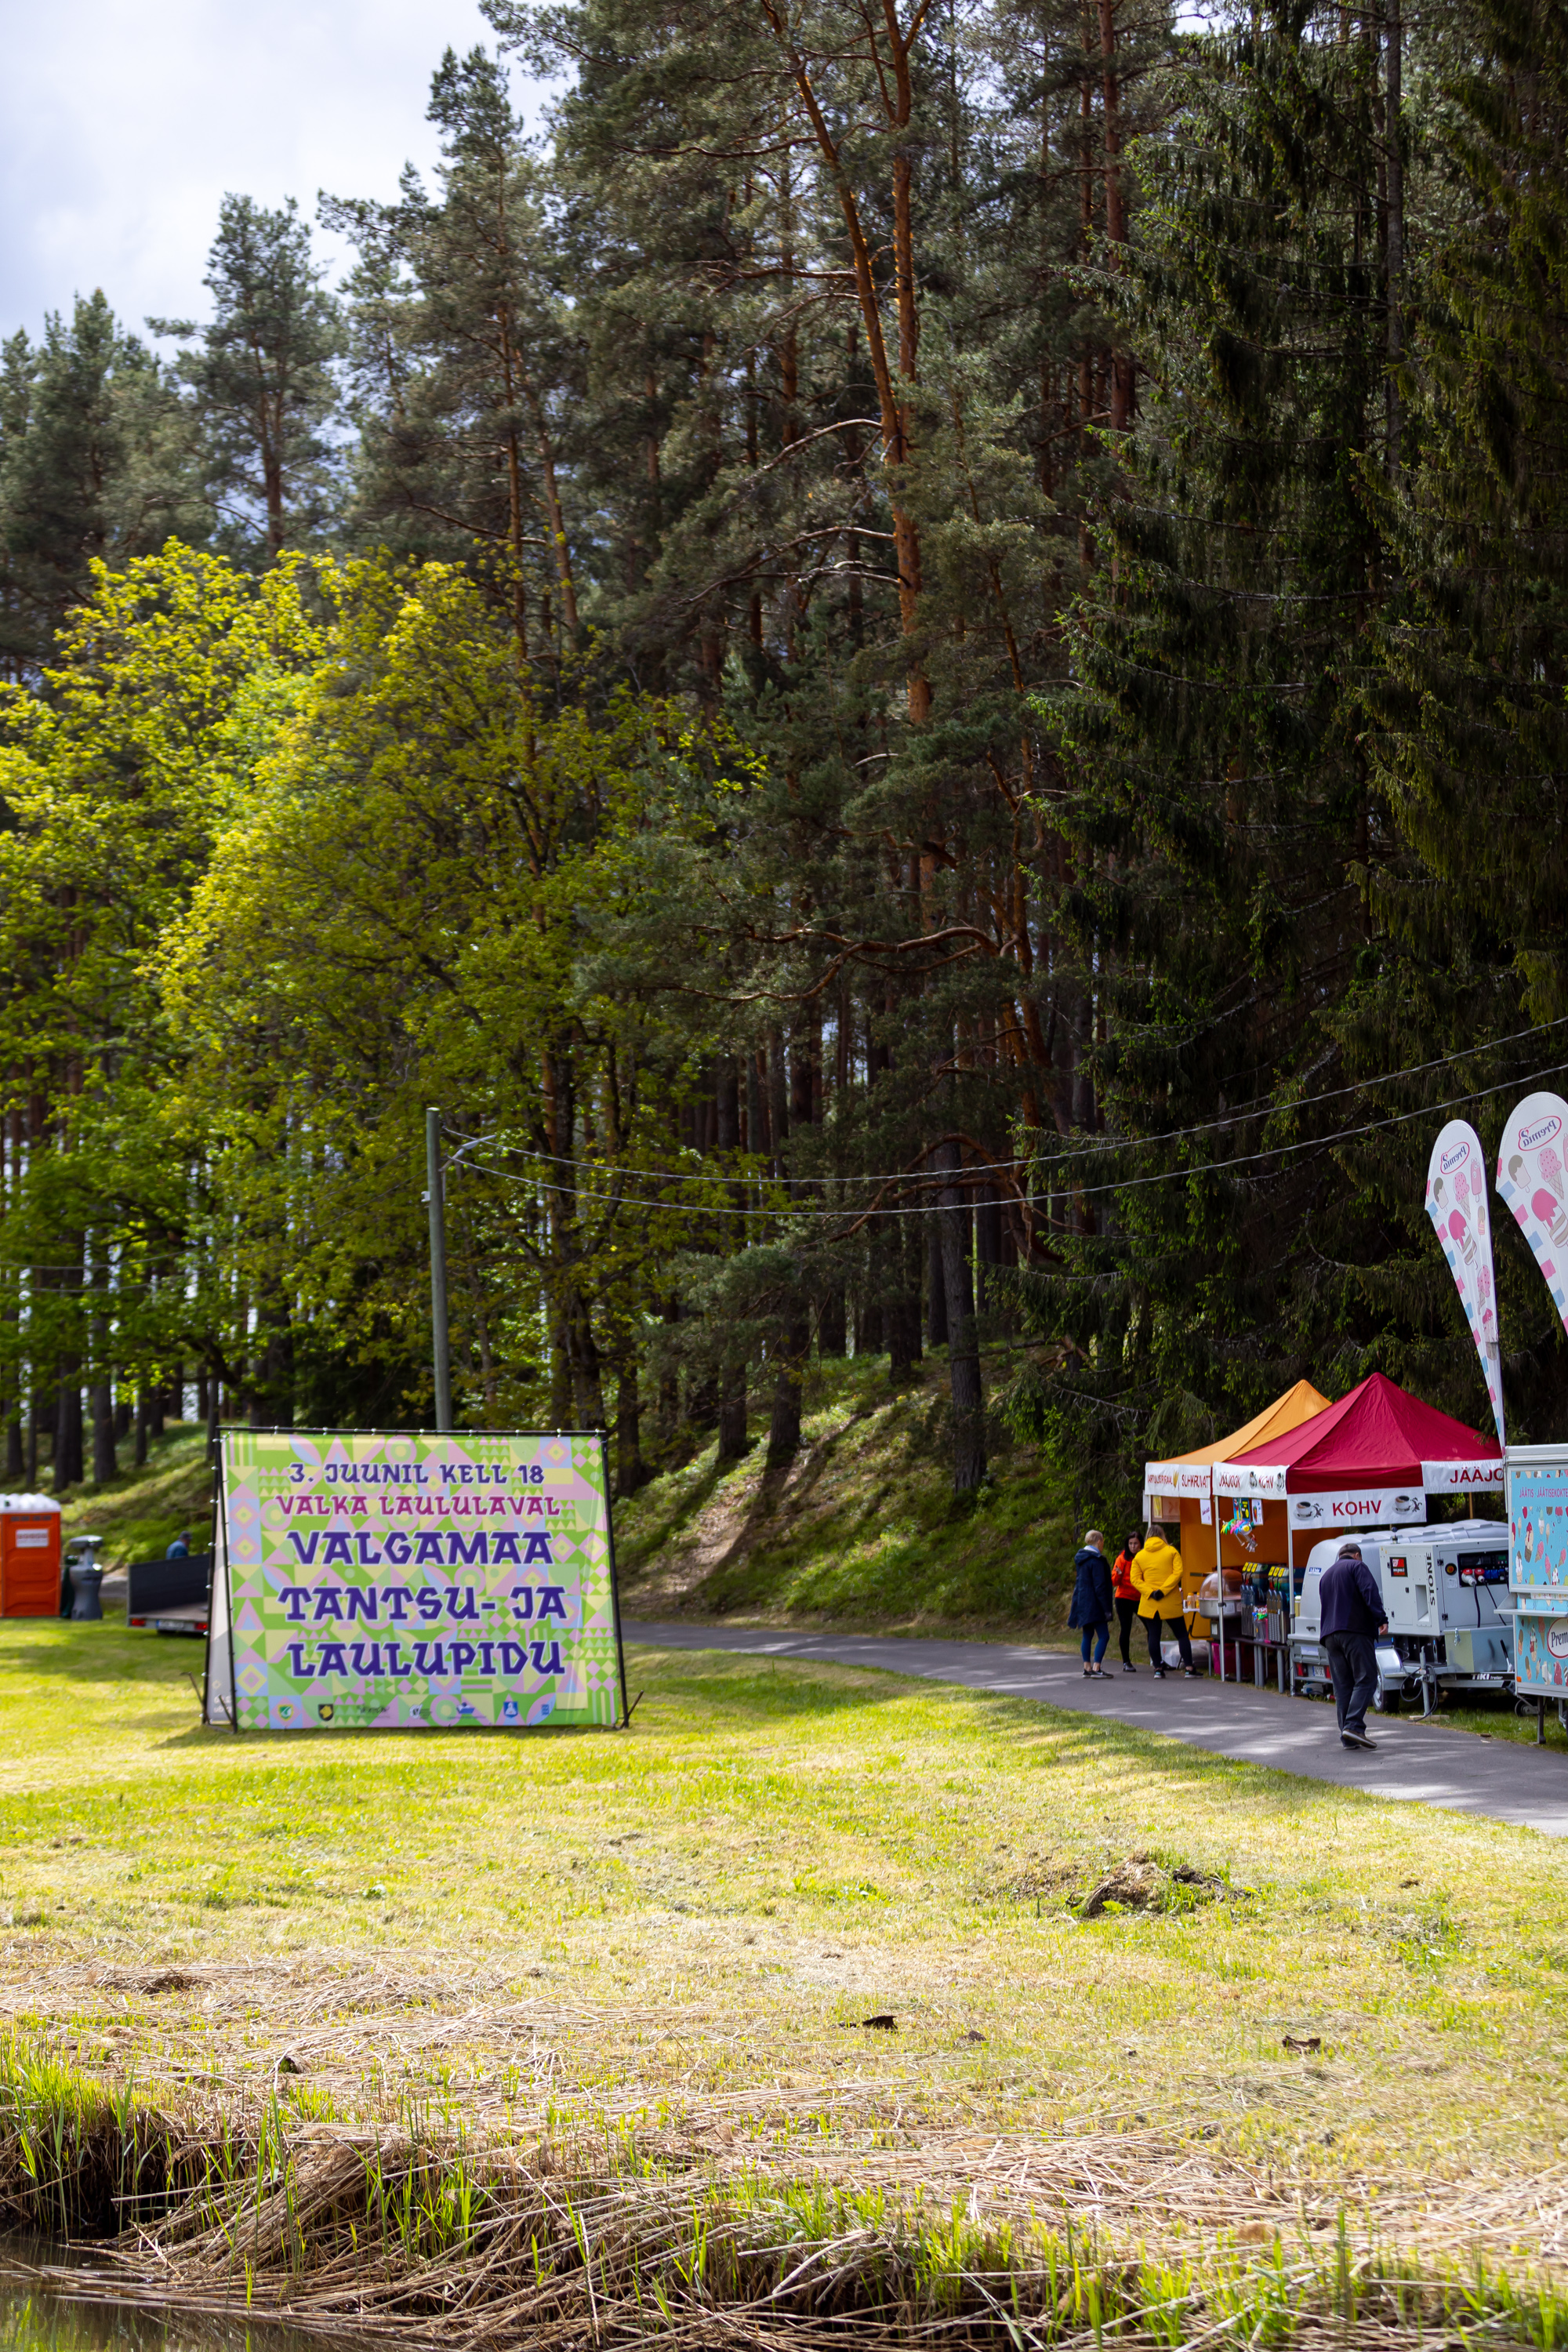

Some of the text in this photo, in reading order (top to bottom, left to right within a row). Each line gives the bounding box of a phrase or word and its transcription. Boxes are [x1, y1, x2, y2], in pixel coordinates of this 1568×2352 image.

[289, 1463, 545, 1484] 3. JUUNIL KELL 18
[1258, 1475, 1274, 1490] KOHV
[1519, 1486, 1534, 1498] JÄÄTIS
[275, 1495, 561, 1516] VALKA LAULULAVAL
[1333, 1500, 1382, 1516] KOHV
[286, 1531, 554, 1566] VALGAMAA
[277, 1585, 568, 1621] TANTSU- JA
[285, 1641, 566, 1677] LAULUPIDU
